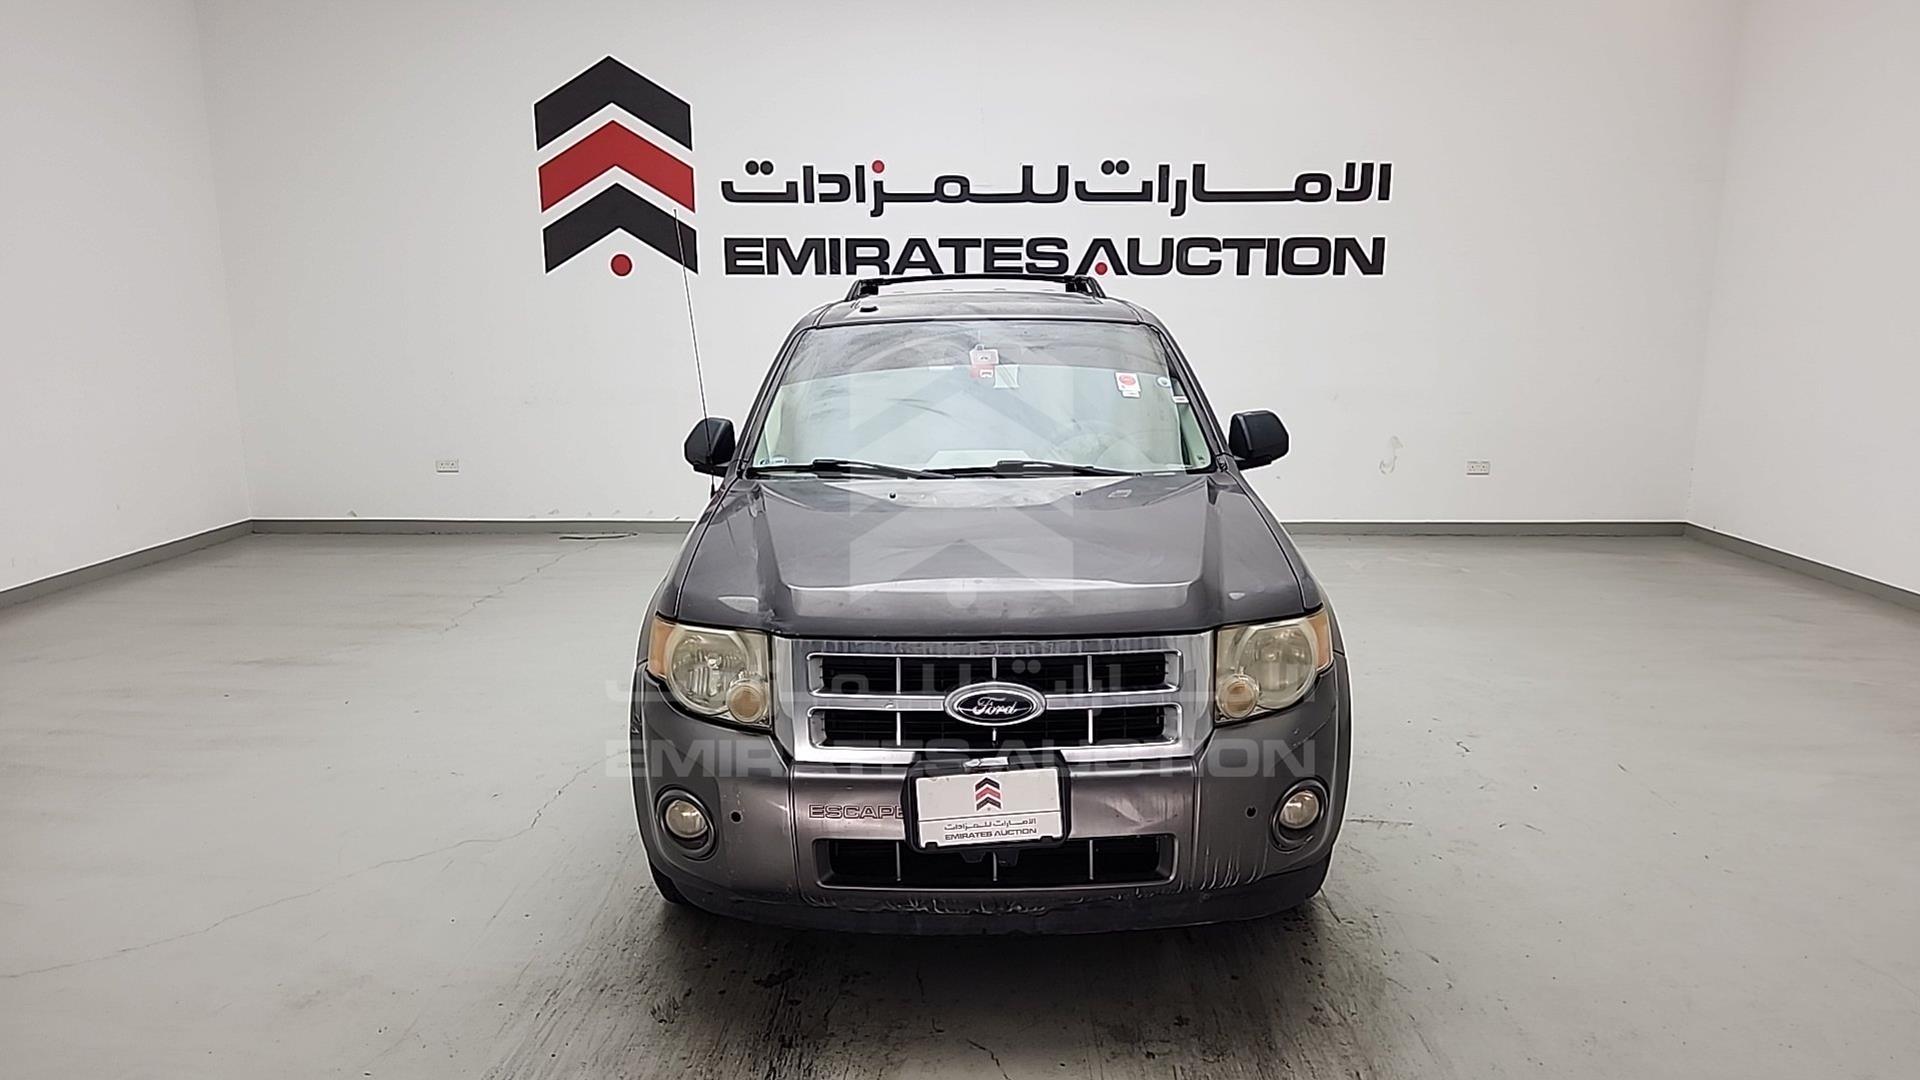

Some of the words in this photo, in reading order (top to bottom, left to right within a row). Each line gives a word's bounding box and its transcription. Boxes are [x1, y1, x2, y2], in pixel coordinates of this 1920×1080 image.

[723, 237, 1069, 276] EMIRATES
[1074, 236, 1387, 276] AUCTION
[972, 696, 1018, 715] Ford
[944, 831, 993, 841] EMIRATES
[994, 828, 1037, 837] AUCTION
